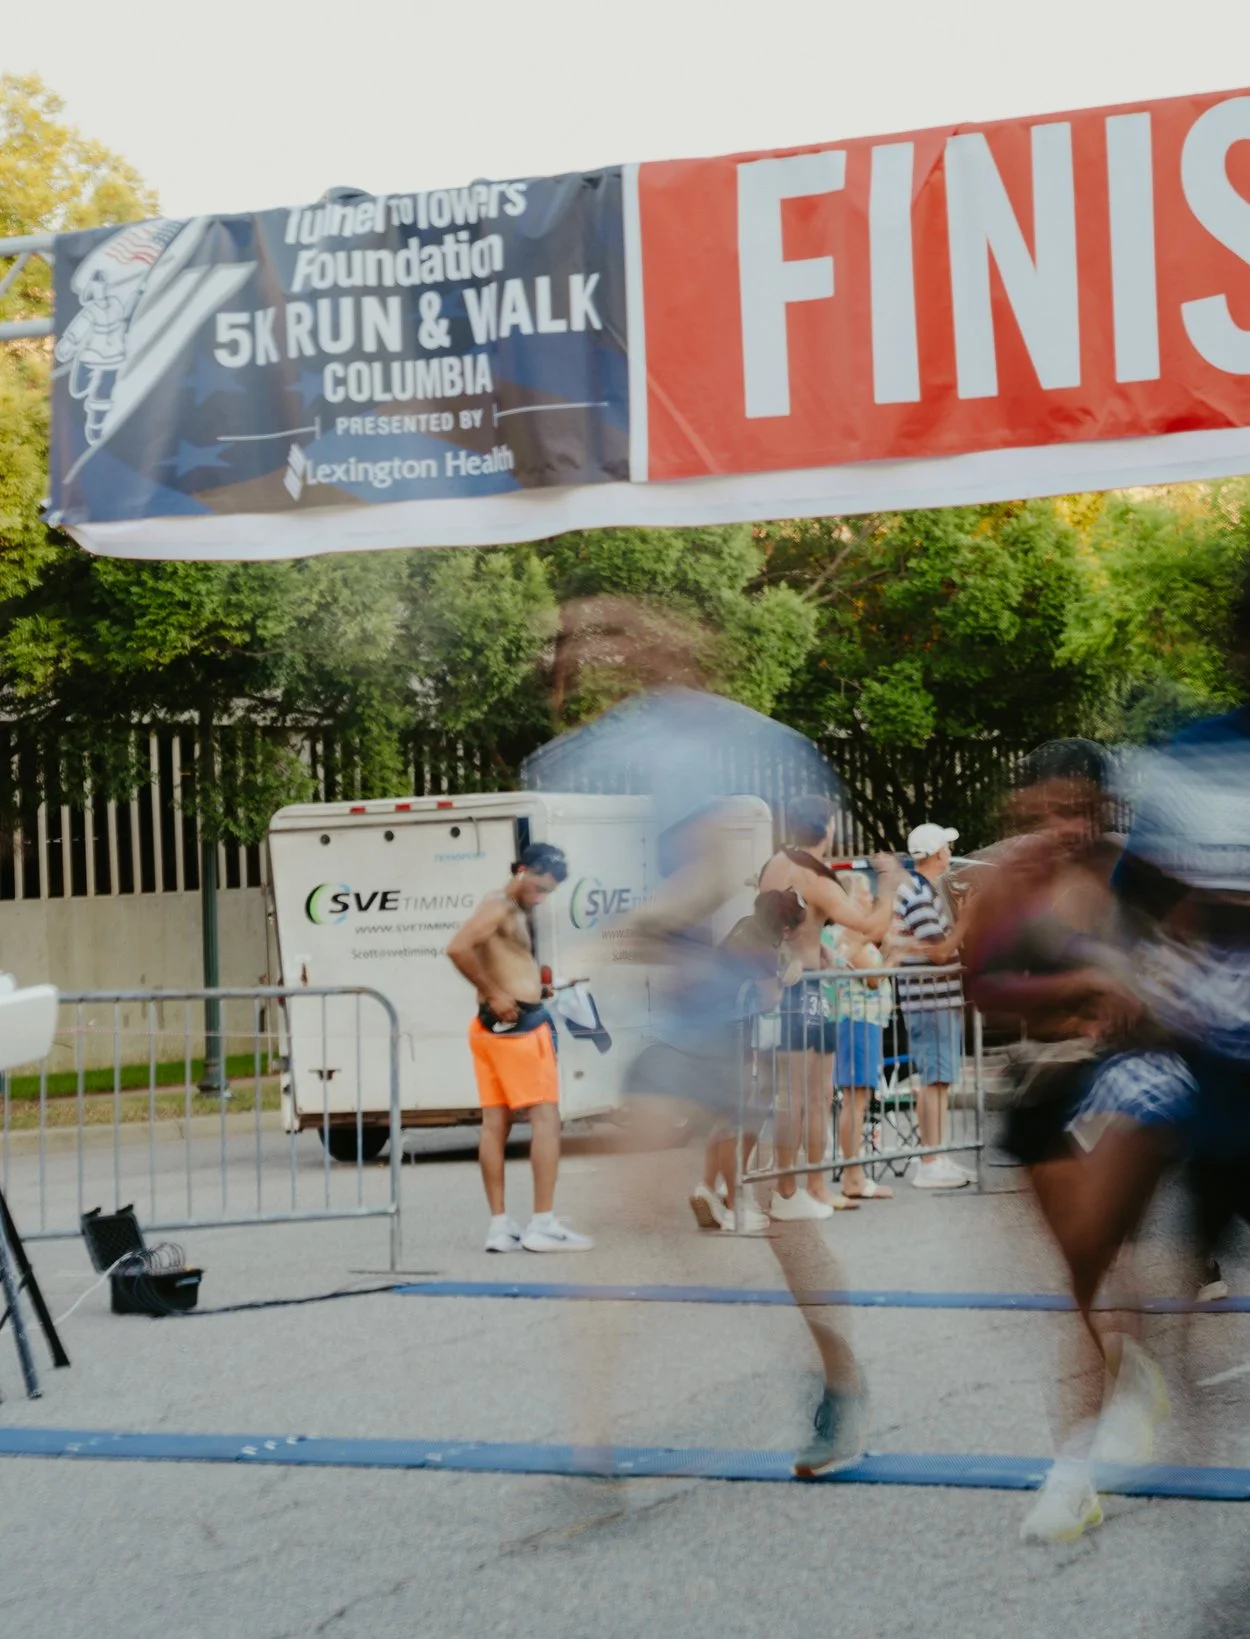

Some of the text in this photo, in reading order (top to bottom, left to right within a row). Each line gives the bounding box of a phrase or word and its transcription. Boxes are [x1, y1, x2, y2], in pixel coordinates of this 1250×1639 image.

[415, 182, 528, 230] Towers
[290, 230, 504, 294] Foundation
[213, 272, 603, 369] 5K RUN & WALK
[323, 352, 494, 404] COLUMBIA
[335, 407, 484, 437] PRESENTED BY
[305, 443, 516, 489] Lexington Health
[328, 889, 475, 915] SVE TIMING
[584, 887, 631, 917] SVE
